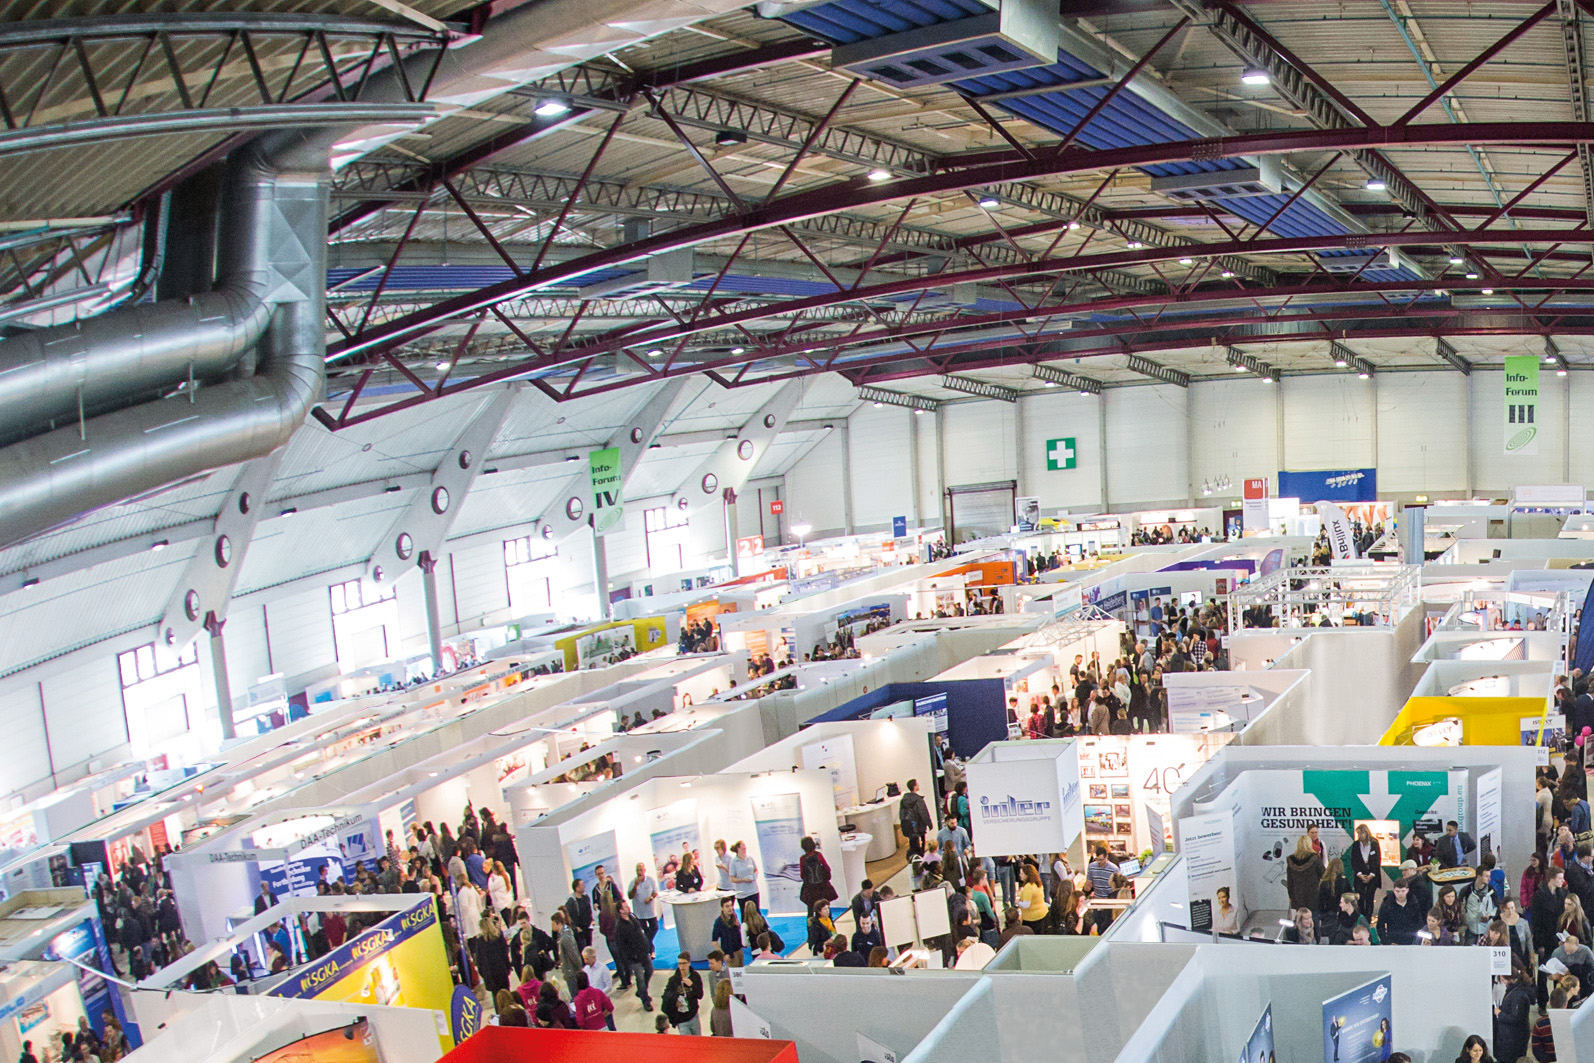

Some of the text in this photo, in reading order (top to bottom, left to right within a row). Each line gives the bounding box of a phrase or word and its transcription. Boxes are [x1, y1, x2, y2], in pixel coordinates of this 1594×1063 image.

[1506, 373, 1528, 382] Info-
[1506, 387, 1537, 396] Forum
[1509, 405, 1534, 423] III
[591, 464, 613, 474] Info-
[592, 475, 622, 486] Forum
[595, 489, 620, 509] IV
[980, 794, 1051, 818] inter
[1261, 807, 1352, 817] WIR BRINGEN
[982, 816, 1051, 825] VERSICHERUNGSGRUPPE
[1261, 818, 1352, 829] GESUNDHEIT!
[300, 813, 363, 850] DAA-Technikum
[208, 853, 257, 863] DAA-Technikum
